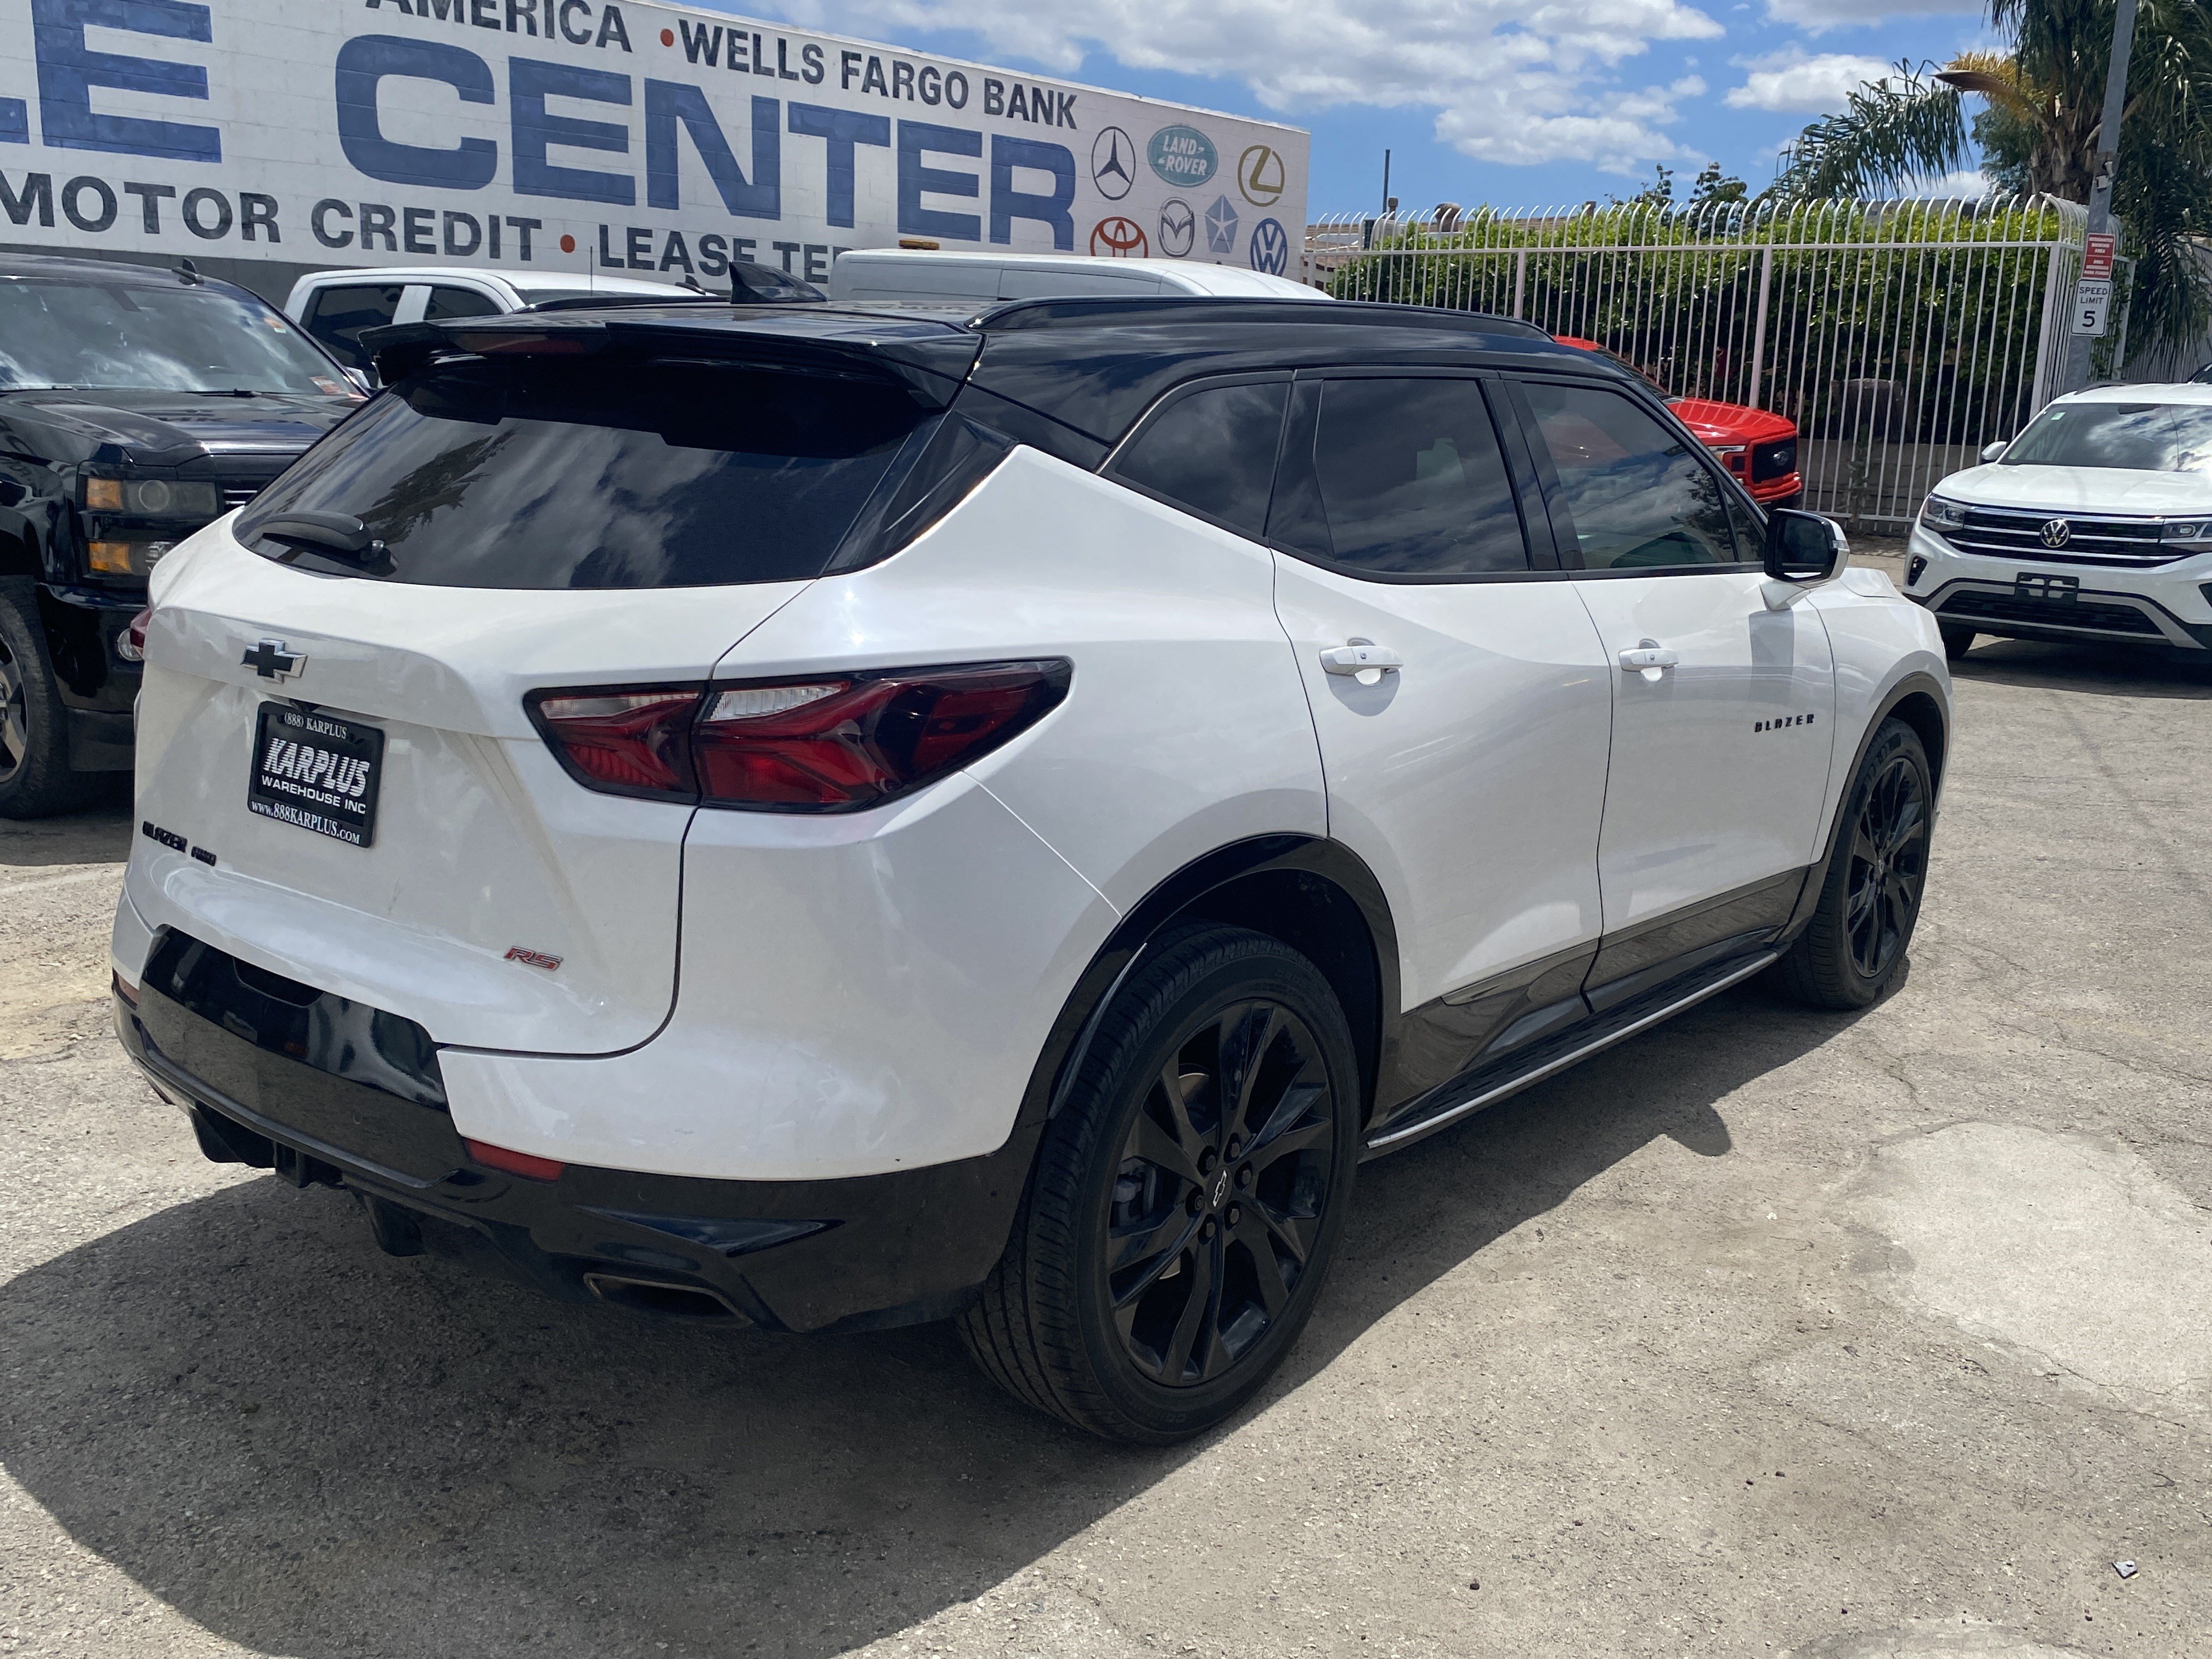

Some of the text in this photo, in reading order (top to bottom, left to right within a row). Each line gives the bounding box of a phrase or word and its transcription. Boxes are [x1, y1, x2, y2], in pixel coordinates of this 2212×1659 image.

[366, 0, 1077, 129] ERICA WELLS FARGO BANK
[335, 34, 1076, 251] CENTER
[0, 171, 854, 284] MOTOR CREDIT LEASE TE
[2079, 286, 2108, 295] SPEED
[2082, 311, 2095, 327] 5
[284, 712, 347, 739] (888) KARPLUS
[1754, 714, 1814, 732] BLAZER
[263, 737, 370, 797] KARPLUS
[262, 775, 366, 814] WAREHOUSE INC
[503, 945, 564, 971] RS
